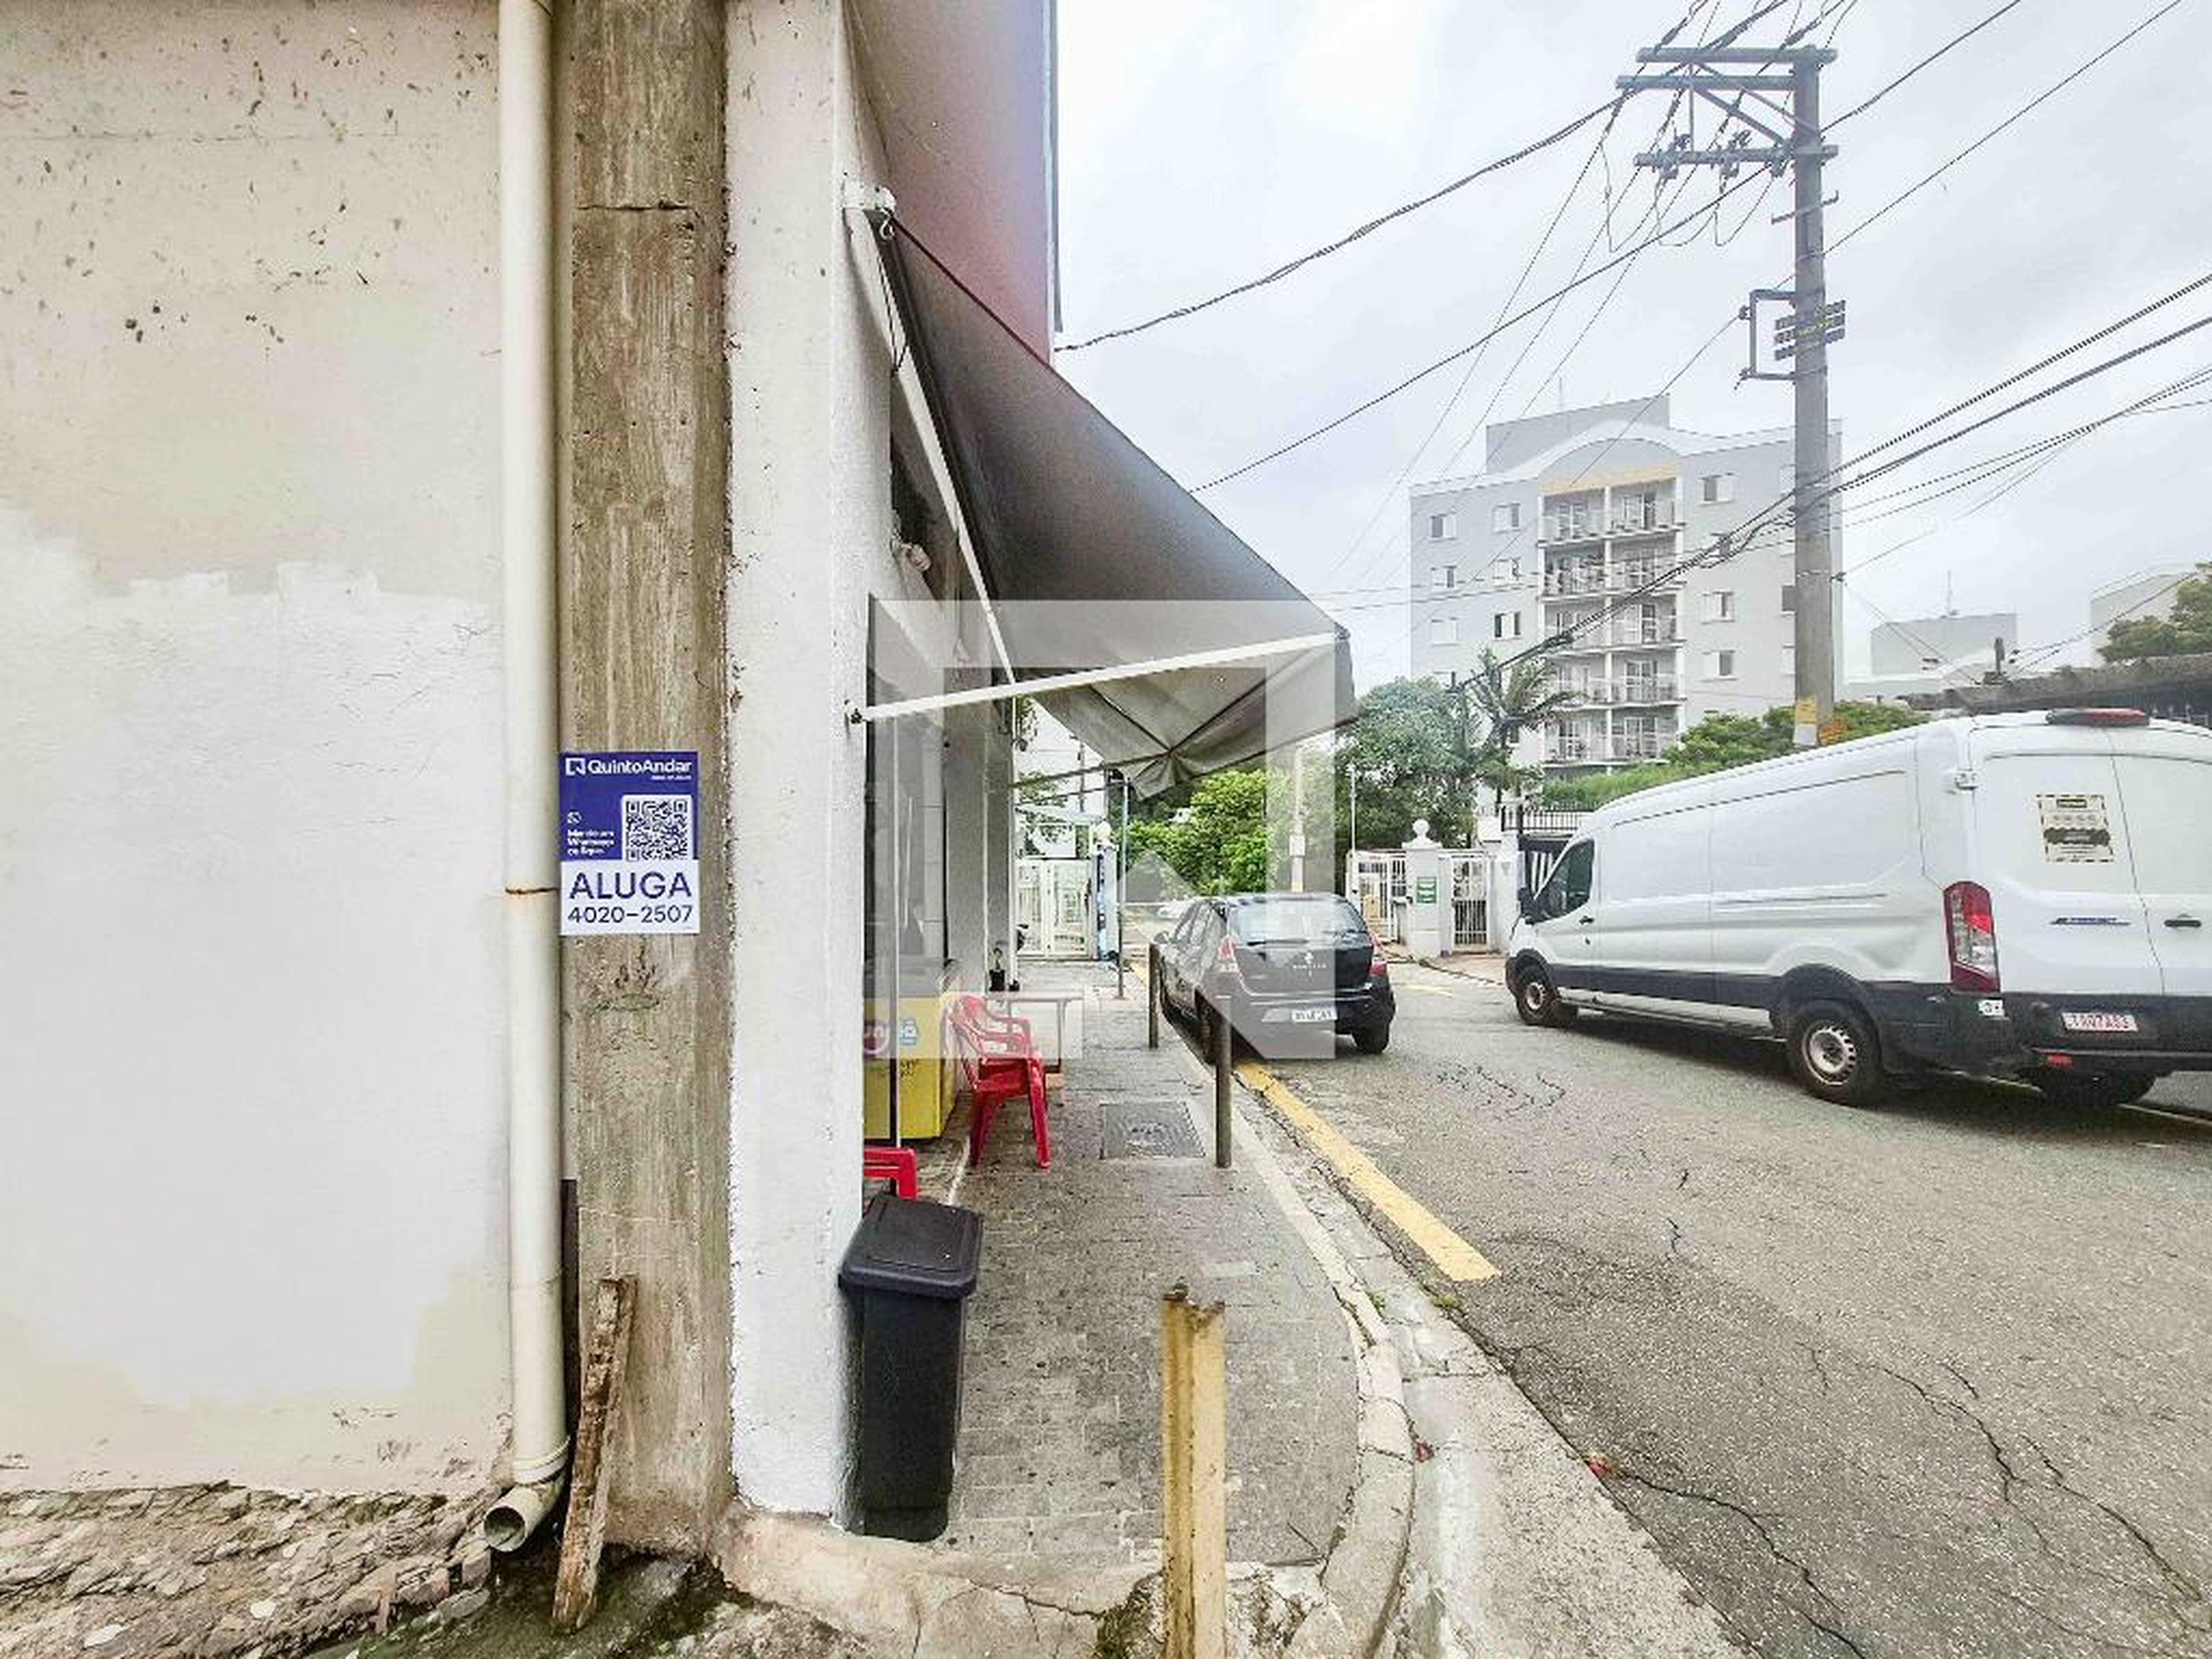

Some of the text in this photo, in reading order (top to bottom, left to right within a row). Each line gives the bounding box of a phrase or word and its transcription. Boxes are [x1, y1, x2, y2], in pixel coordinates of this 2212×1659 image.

[588, 759, 692, 774] QuintoAndar
[568, 872, 692, 899] ALUGA
[567, 905, 693, 923] 4020-2507
